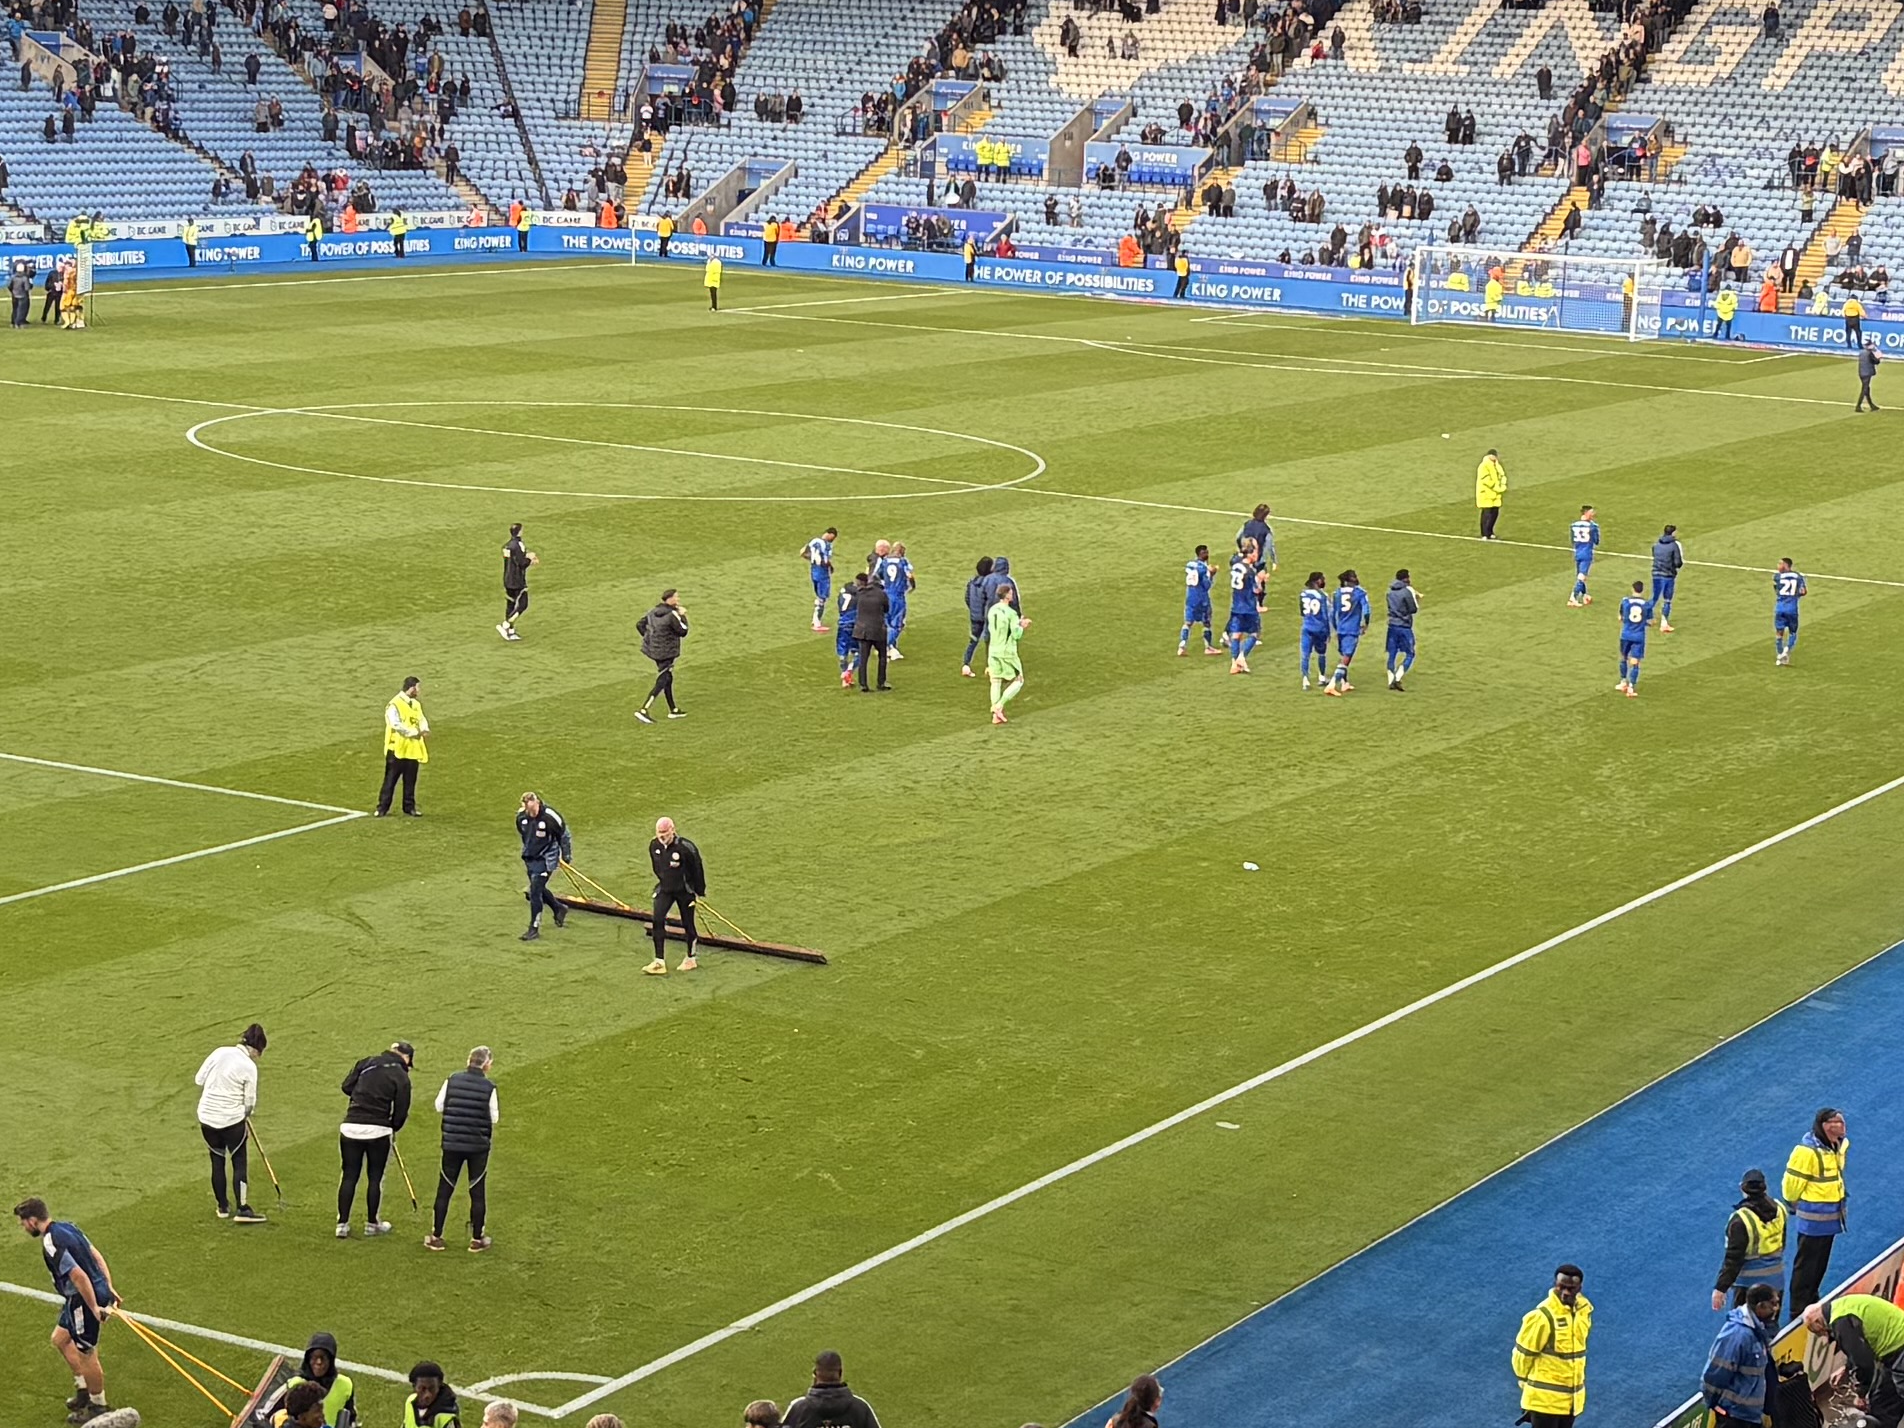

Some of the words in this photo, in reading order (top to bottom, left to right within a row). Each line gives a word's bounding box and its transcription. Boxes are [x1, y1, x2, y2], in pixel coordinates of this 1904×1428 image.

[1143, 151, 1178, 163] POWER
[321, 243, 354, 257] POWER
[357, 242, 369, 255] OF
[455, 237, 476, 250] KING
[479, 236, 511, 249] POWER
[562, 235, 589, 249] THE
[594, 236, 641, 251] POWER
[196, 248, 222, 262] KING
[832, 253, 865, 269] KING
[869, 256, 914, 273] POWER
[995, 266, 1041, 283] POWER
[1046, 270, 1063, 285] OF
[1066, 271, 1154, 293] POSSIBILITIES
[1191, 282, 1228, 299] KING
[1232, 284, 1281, 302] POWER
[1341, 292, 1367, 309] THE
[1790, 325, 1819, 341] THE
[887, 563, 898, 582] 9
